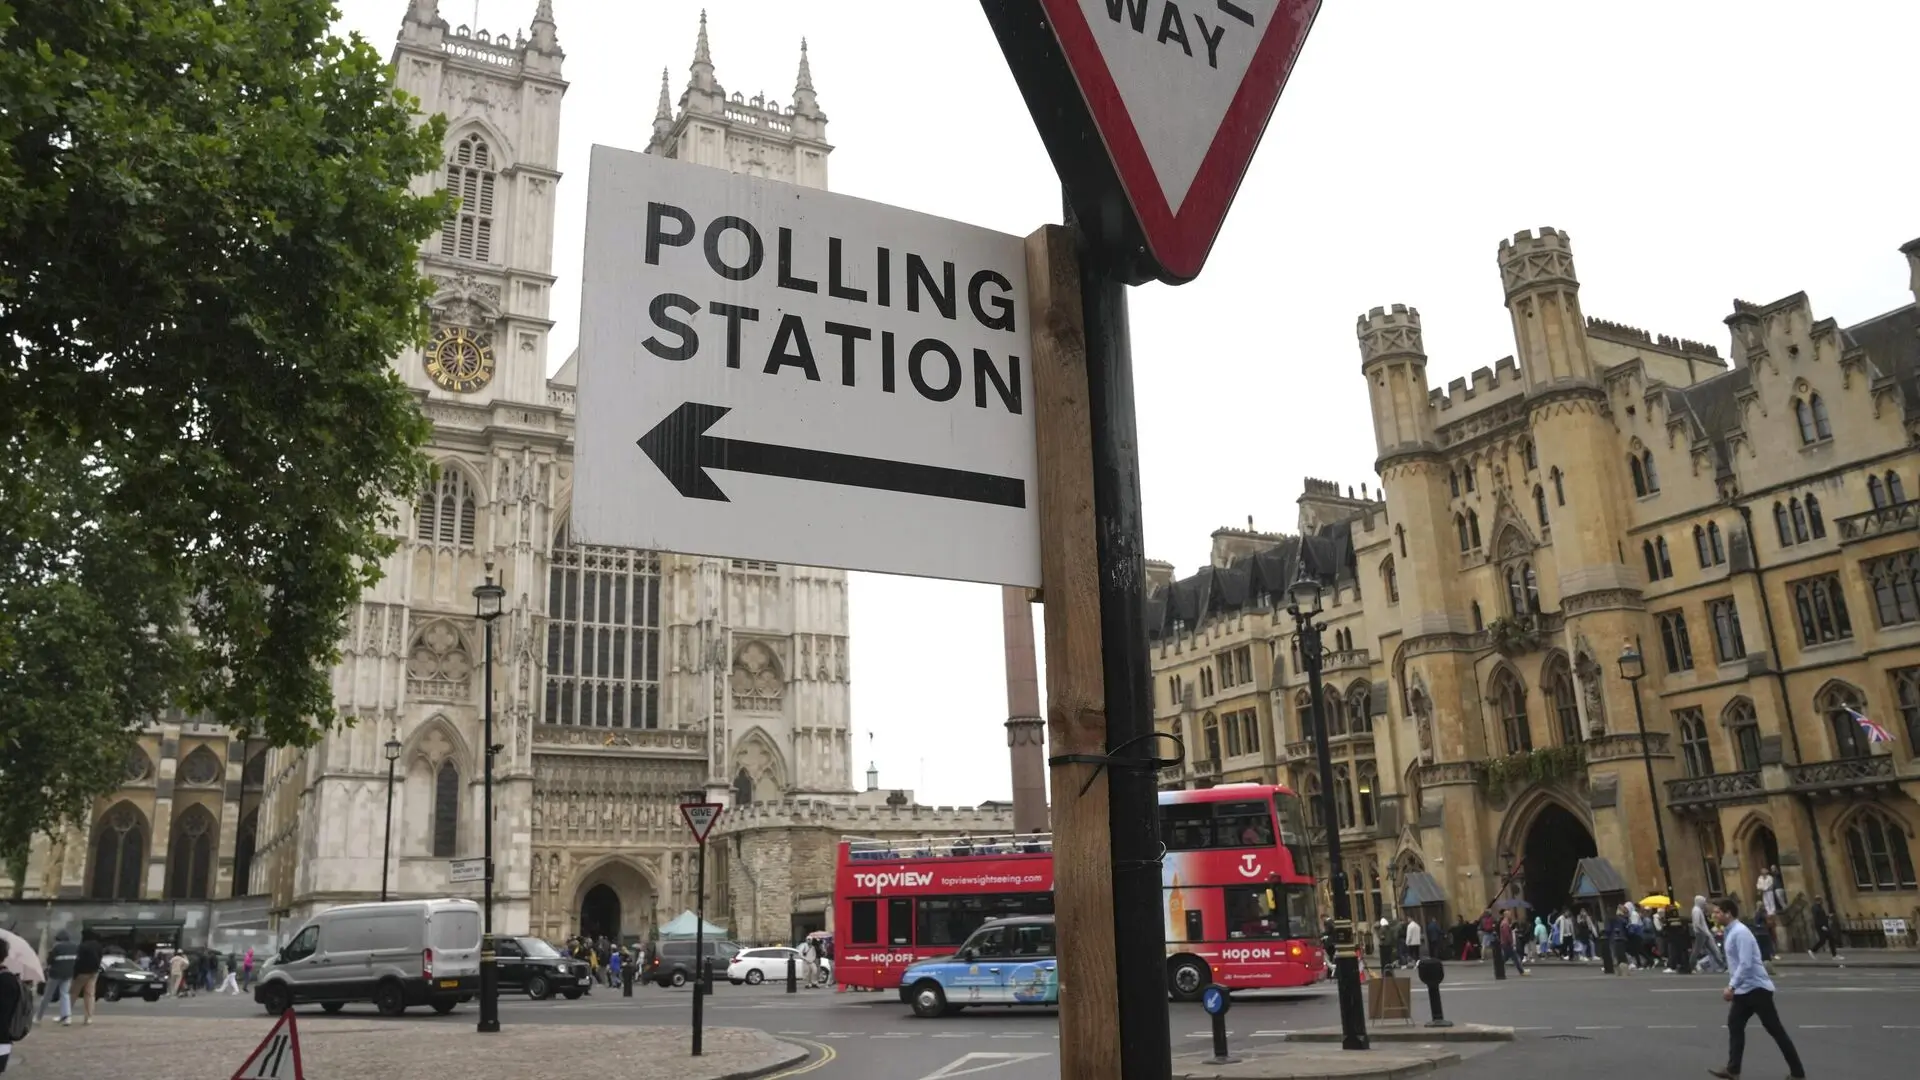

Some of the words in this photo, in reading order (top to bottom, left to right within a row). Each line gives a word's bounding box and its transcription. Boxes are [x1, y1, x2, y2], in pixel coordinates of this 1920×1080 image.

[1105, 0, 1225, 69] WAY
[644, 201, 1015, 332] POLLING
[641, 292, 1022, 415] STATION
[691, 808, 712, 817] GIVE
[941, 874, 1042, 886] topviewsightseeing.com
[894, 953, 914, 962] OFF
[1252, 948, 1270, 958] ON
